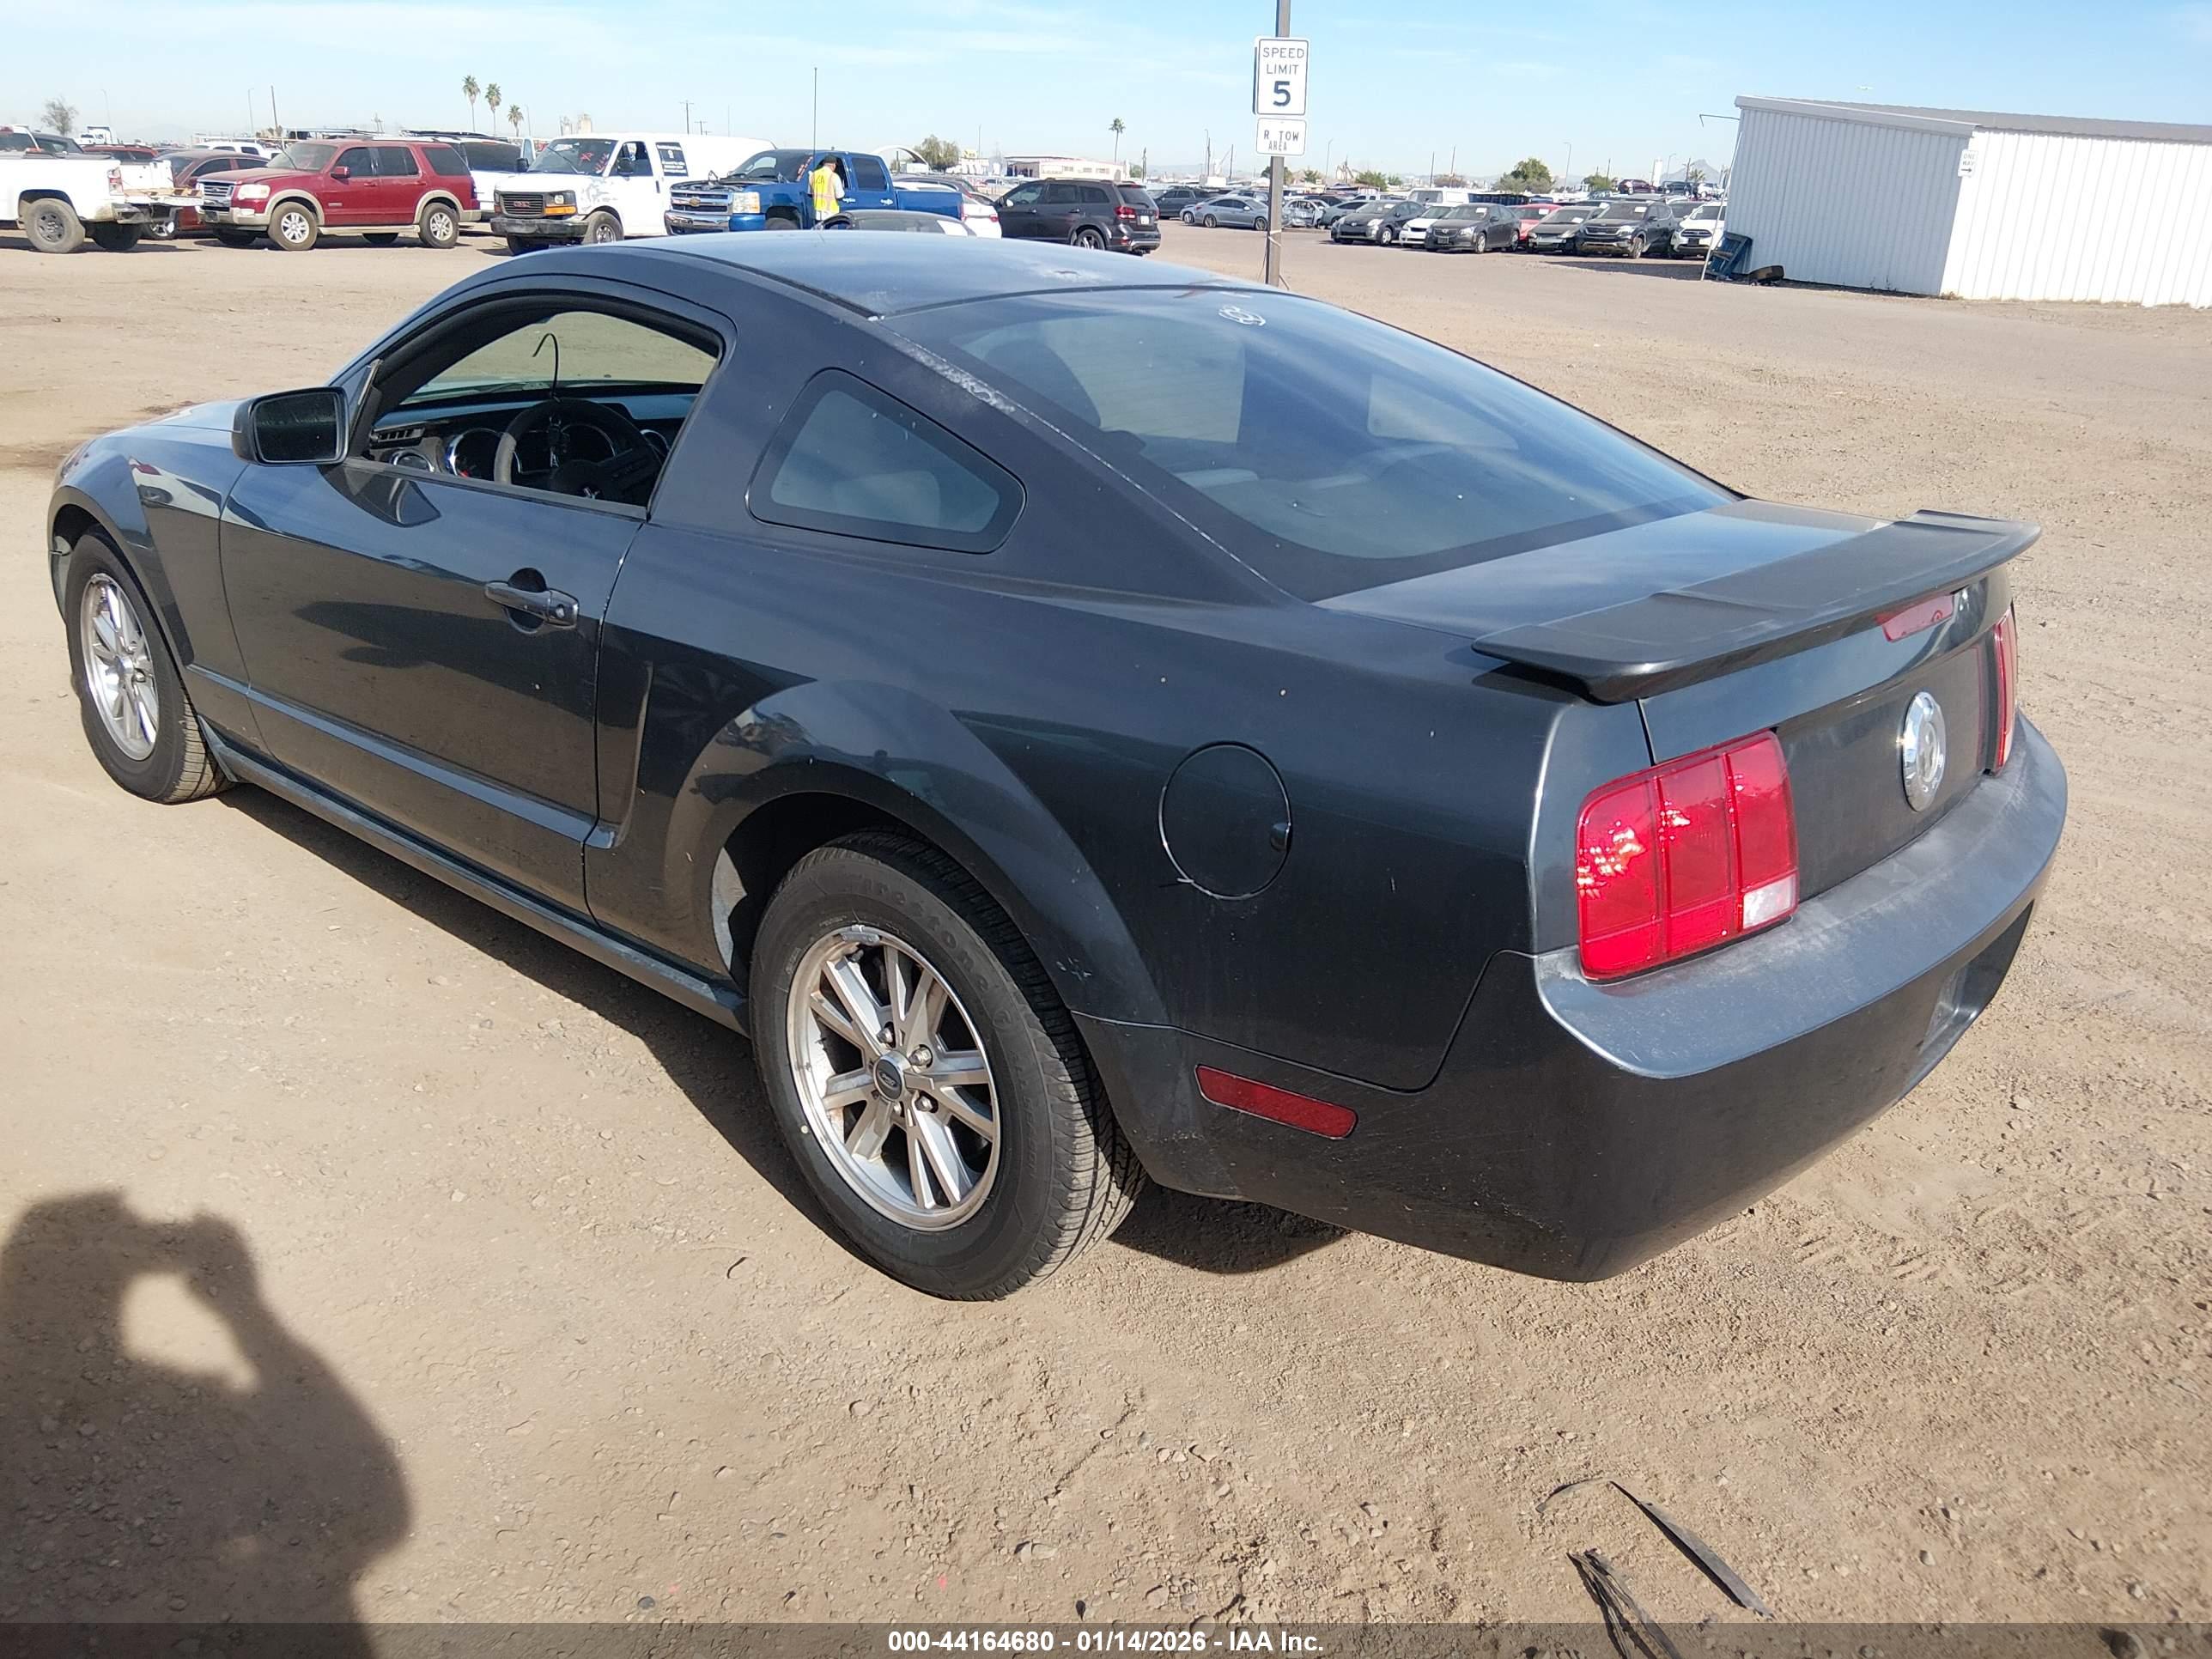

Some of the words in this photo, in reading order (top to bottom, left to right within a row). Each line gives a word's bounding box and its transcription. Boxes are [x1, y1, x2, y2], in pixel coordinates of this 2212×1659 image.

[1262, 47, 1305, 58] SPEED
[1266, 64, 1299, 75] LIMIT
[1273, 81, 1291, 106] 5
[1279, 131, 1299, 142] TOW
